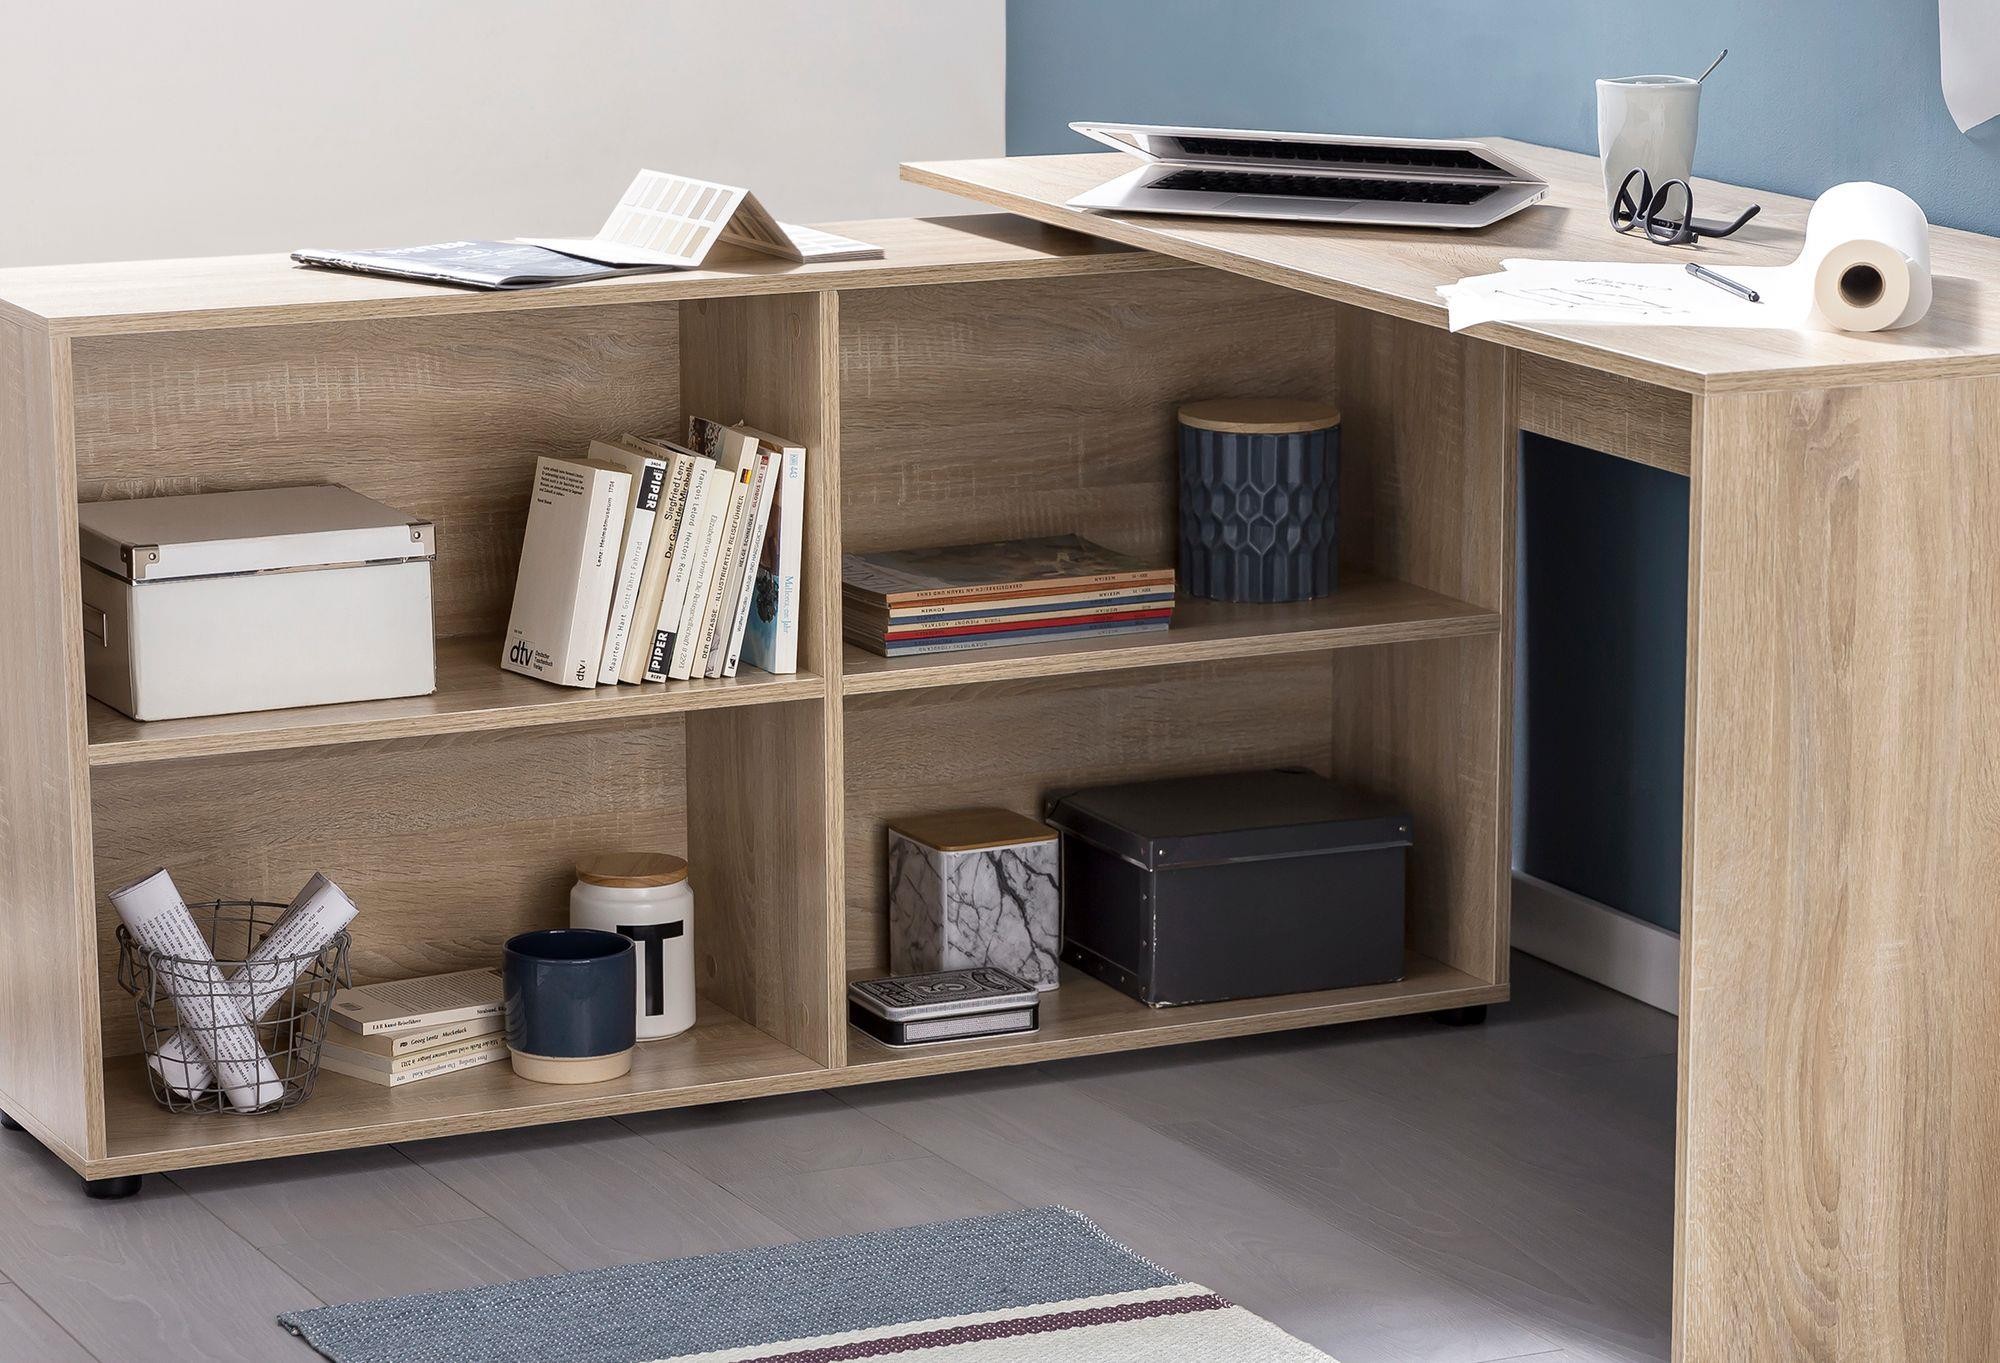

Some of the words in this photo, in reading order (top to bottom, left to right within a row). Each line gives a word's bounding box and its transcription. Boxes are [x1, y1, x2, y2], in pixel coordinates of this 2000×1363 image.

[646, 470, 663, 509] PIPER
[664, 482, 681, 521] Siegfried
[677, 460, 686, 479] Lenz
[679, 462, 694, 503] Mirabelle
[694, 469, 708, 500] François
[599, 497, 612, 548] Heimatmuseum
[675, 505, 685, 517] der
[688, 503, 700, 527] Lelord
[669, 520, 680, 541] Geist
[632, 541, 644, 570] Fahrrad
[665, 547, 674, 559] Der
[680, 531, 693, 560] Hectors
[675, 562, 686, 583] Reise
[622, 594, 632, 609] Gott
[618, 614, 627, 631] Hart
[510, 640, 533, 666] dtv
[608, 644, 620, 672] Maarten
[652, 632, 669, 669] PIPER
[576, 664, 586, 681] dtv
[616, 920, 684, 1016] T
